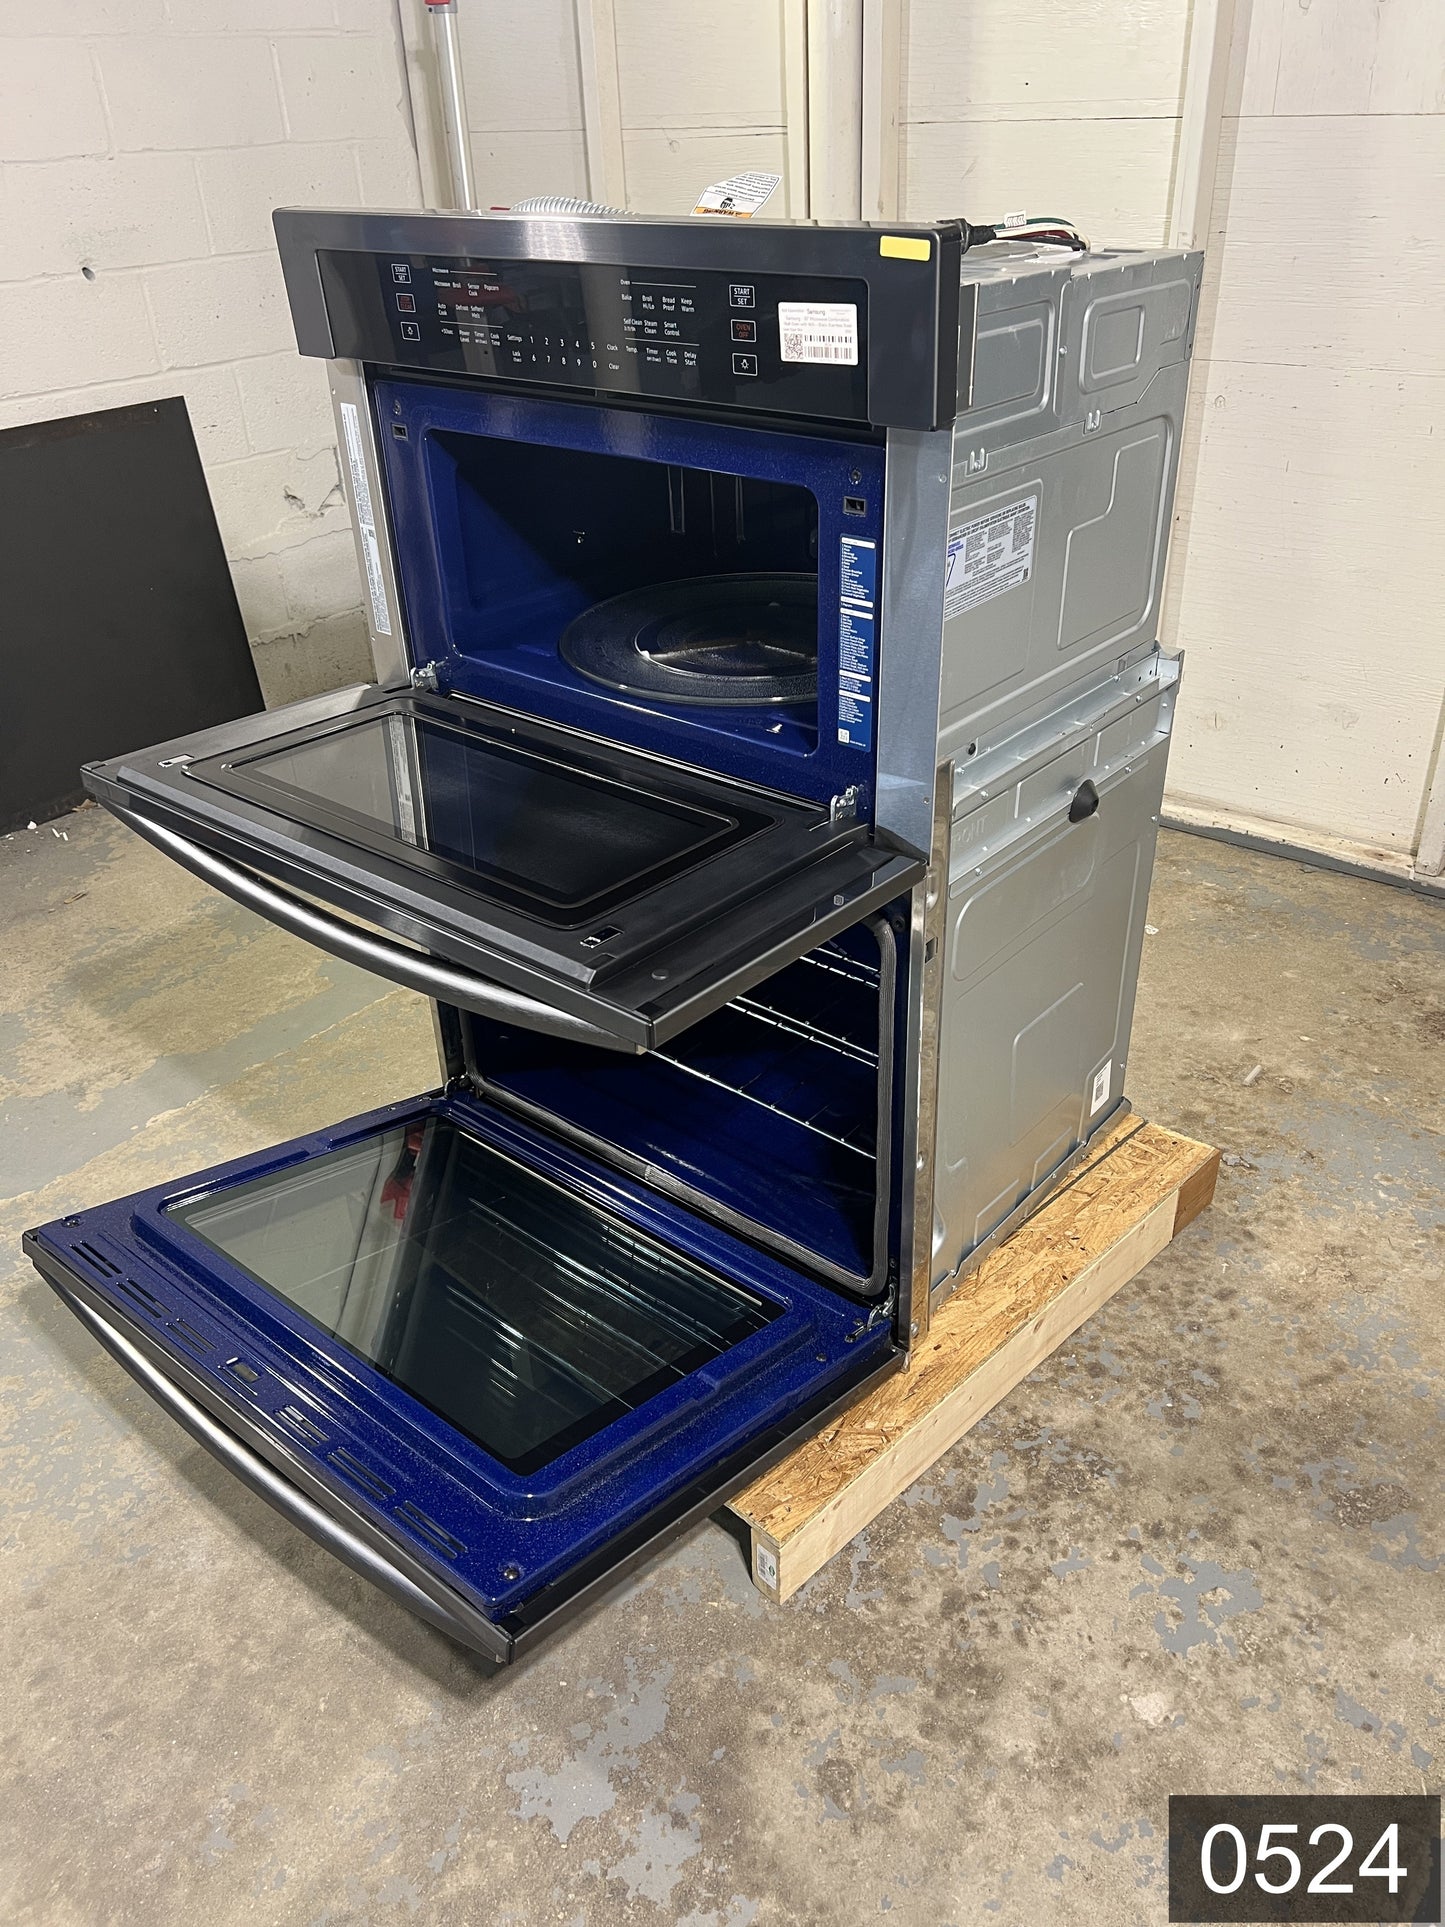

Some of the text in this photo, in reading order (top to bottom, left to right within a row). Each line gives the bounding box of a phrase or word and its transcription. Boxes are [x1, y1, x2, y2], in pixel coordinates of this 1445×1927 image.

[736, 323, 751, 331] OVEN
[507, 334, 522, 342] Settings
[560, 339, 564, 347] 3
[591, 341, 596, 350] 5
[626, 345, 638, 354] Temp.
[562, 357, 566, 365] 8
[592, 360, 597, 368] 0
